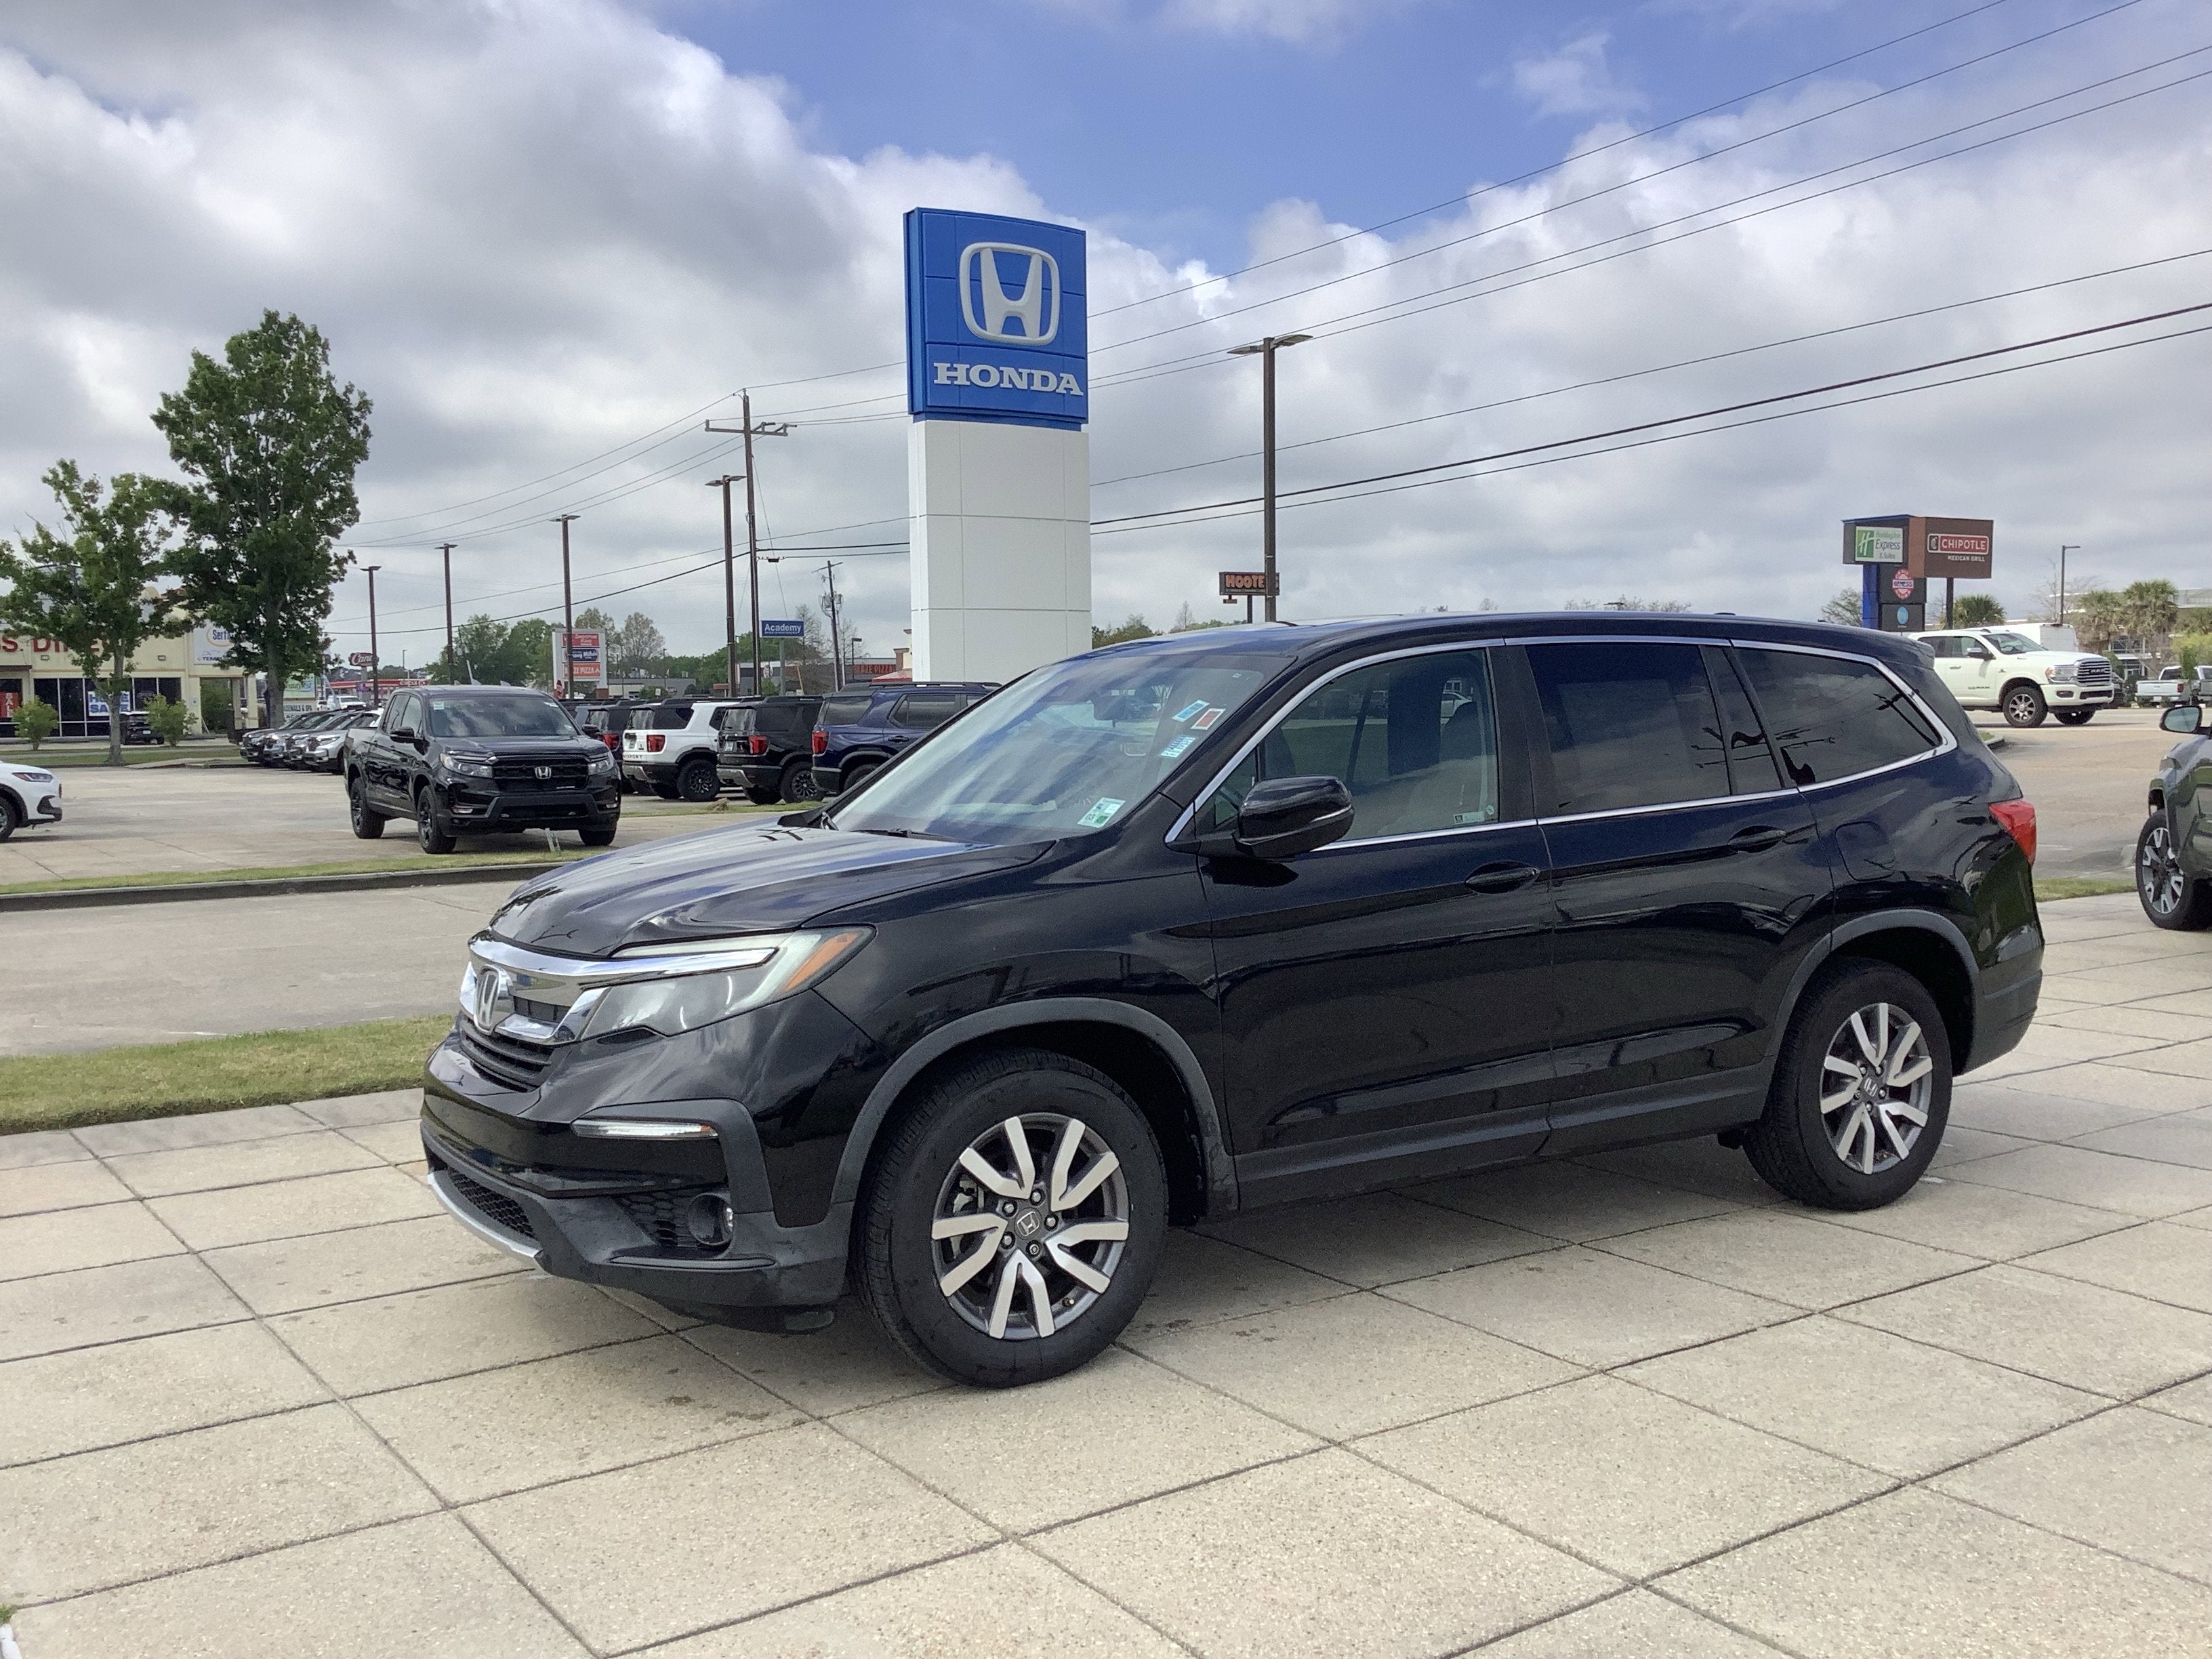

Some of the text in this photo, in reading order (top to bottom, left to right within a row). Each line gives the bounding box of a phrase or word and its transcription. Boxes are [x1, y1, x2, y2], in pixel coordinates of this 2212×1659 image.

[933, 362, 1084, 396] HONDA
[1876, 539, 1901, 551] Express
[1941, 539, 1986, 550] CHIPOTLE
[1225, 574, 1279, 588] HOOTE
[764, 623, 802, 634] Academy
